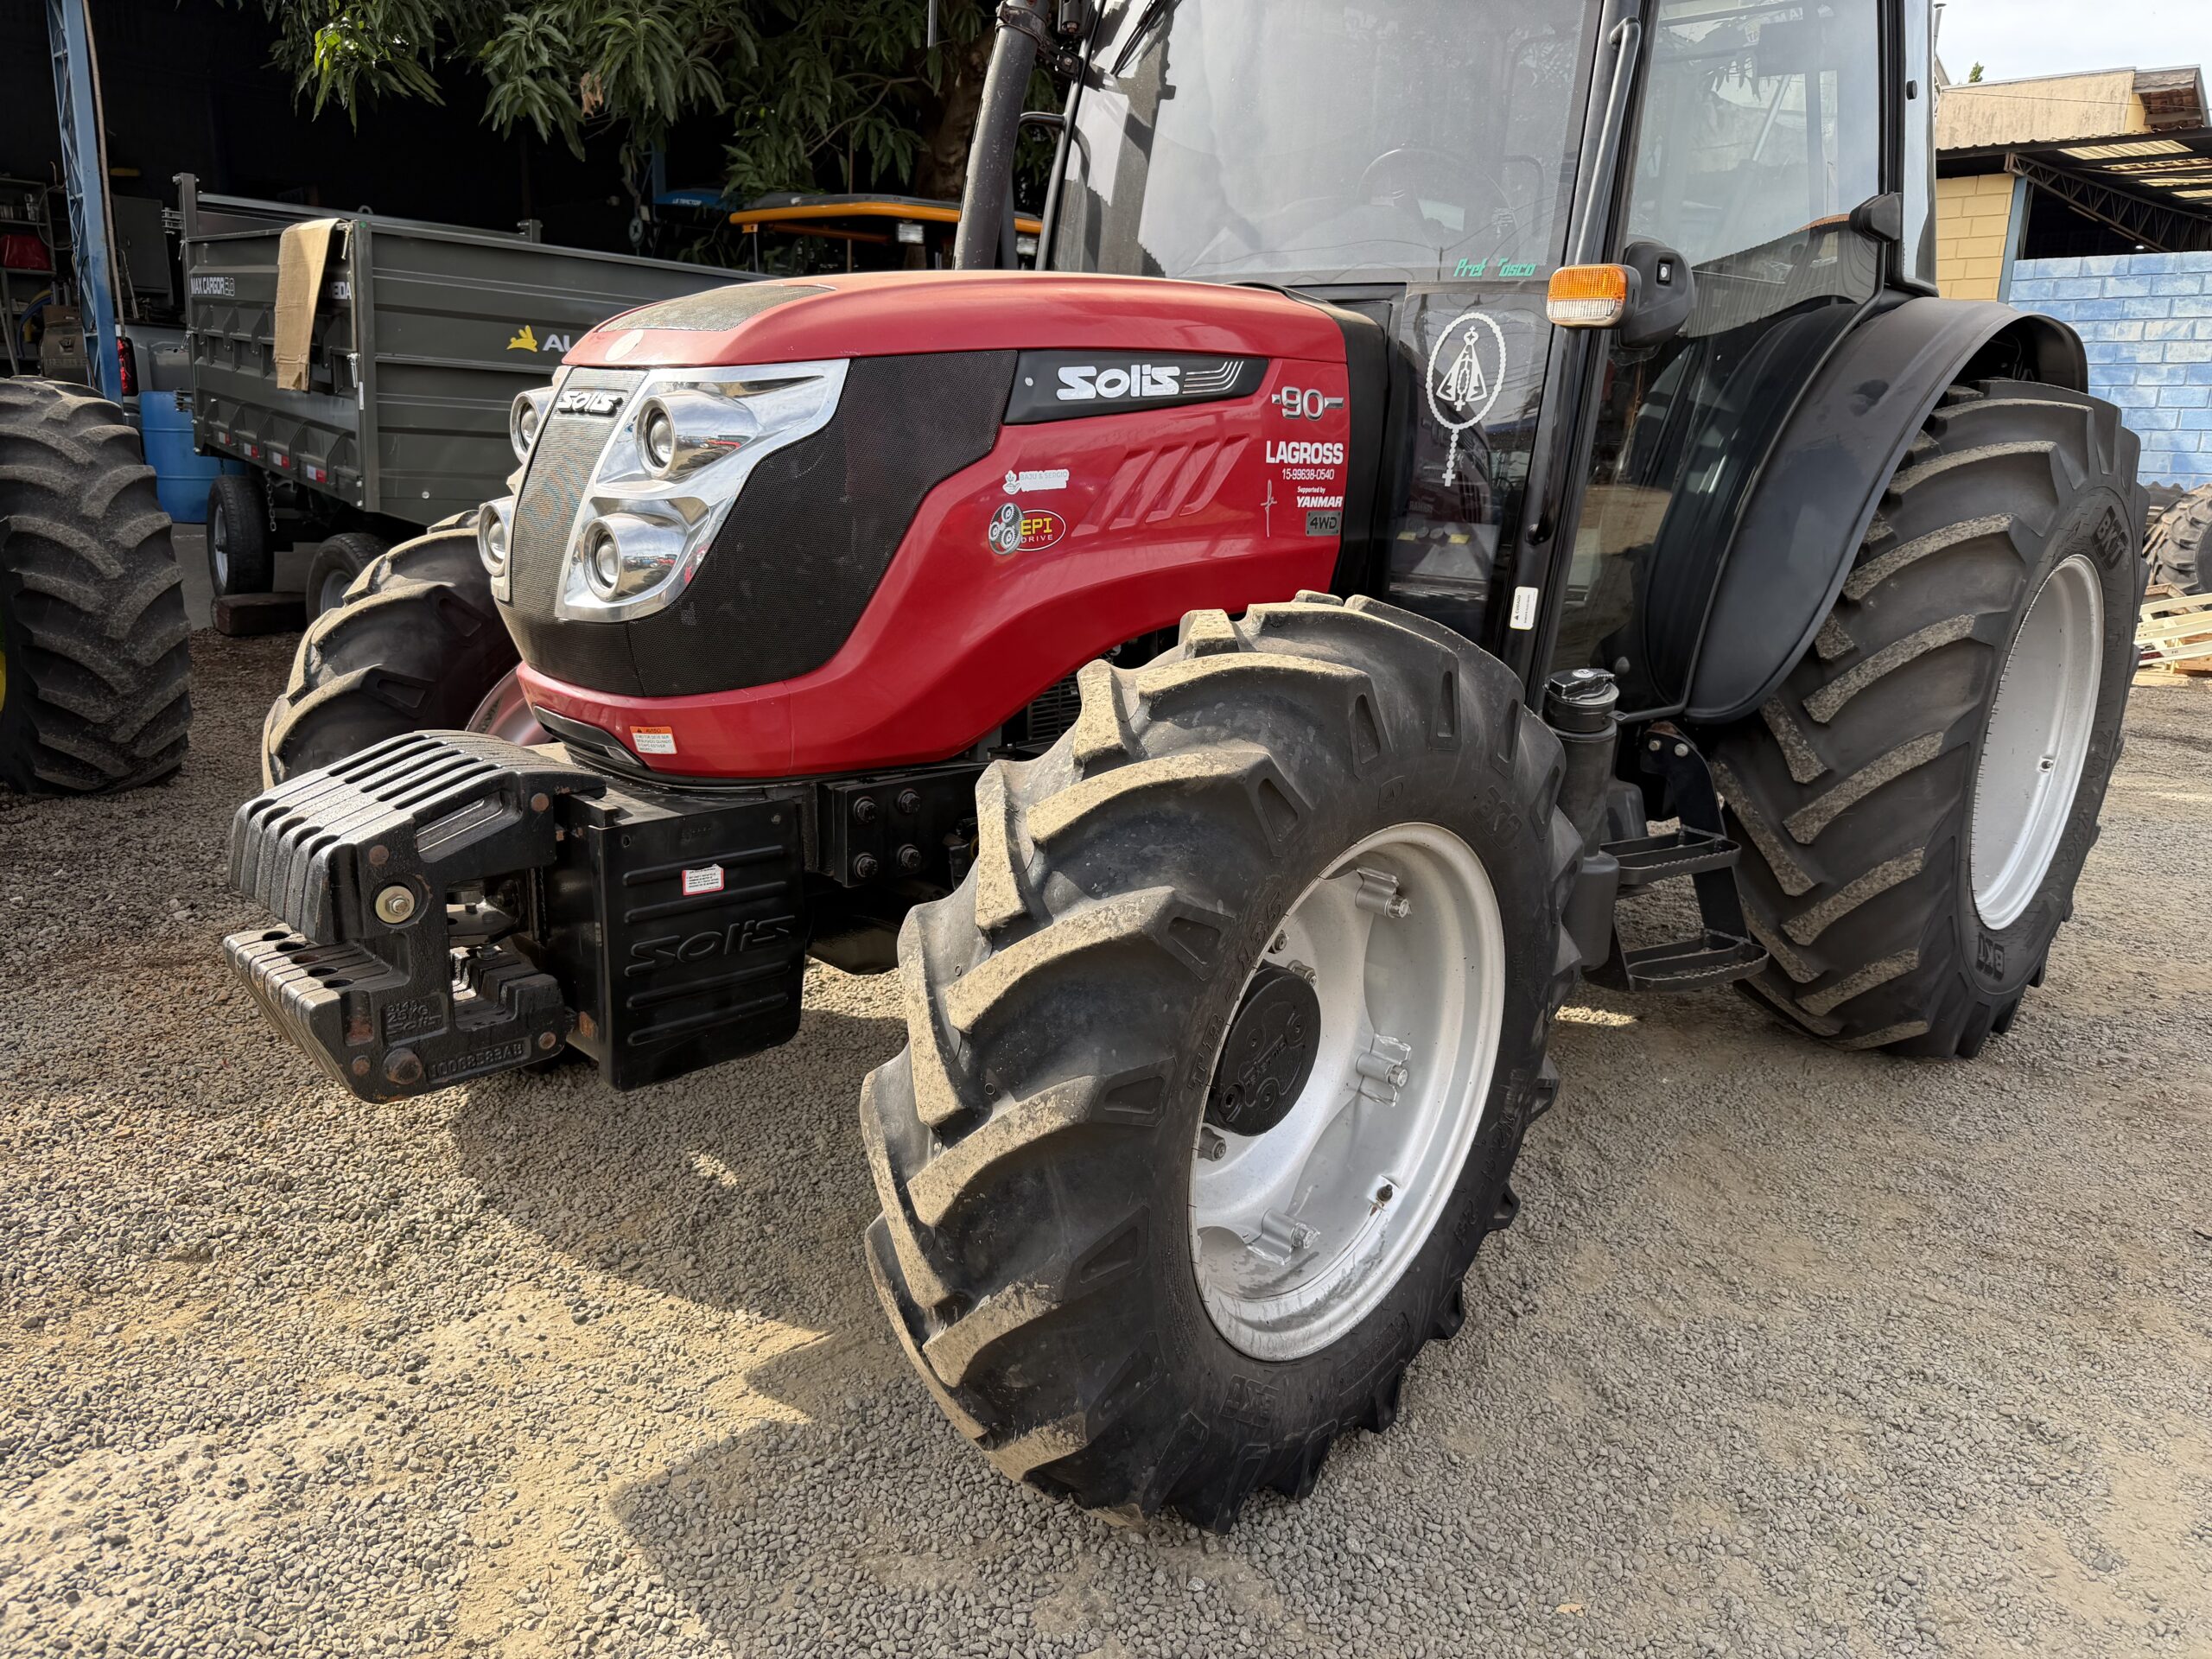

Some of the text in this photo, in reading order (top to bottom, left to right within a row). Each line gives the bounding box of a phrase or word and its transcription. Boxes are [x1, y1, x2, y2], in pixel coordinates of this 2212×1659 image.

[1265, 440, 1344, 465] LAGROSS
[1044, 471, 1068, 480] SERGIO
[1281, 467, 1336, 480] 15-99638-0540
[1297, 486, 1319, 494] Supported
[1296, 496, 1344, 508] YANMAR
[1020, 517, 1052, 536] EPI
[1310, 516, 1338, 530] 4WD
[1020, 534, 1053, 543] DRIVE
[2091, 505, 2129, 570] BKT
[1974, 931, 2005, 982] BKT
